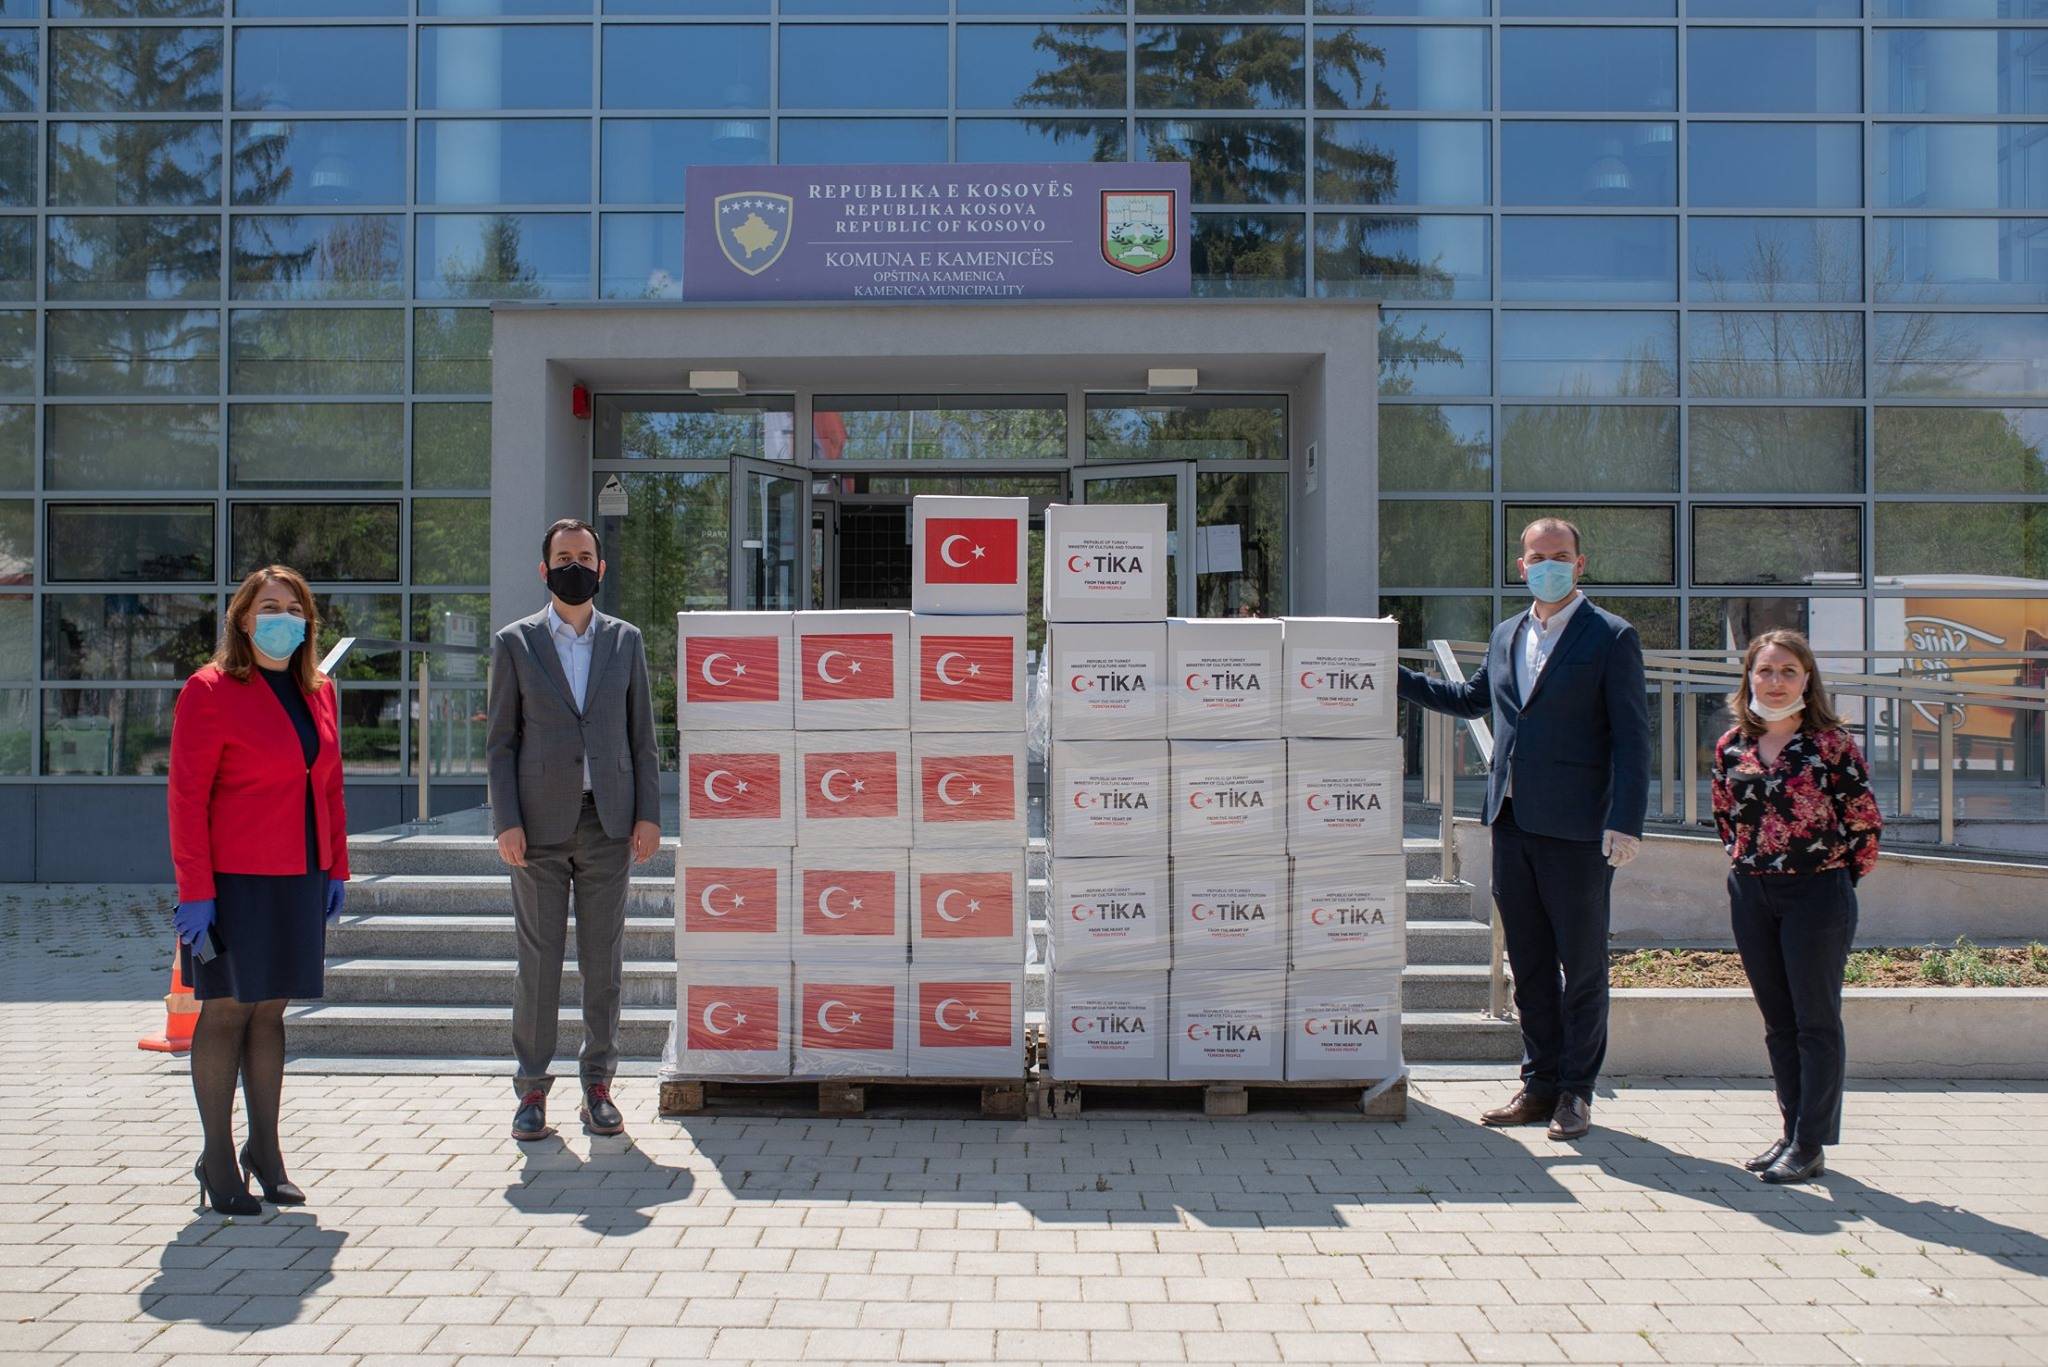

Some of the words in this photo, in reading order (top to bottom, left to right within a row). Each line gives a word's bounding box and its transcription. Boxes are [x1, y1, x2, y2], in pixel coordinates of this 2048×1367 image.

[809, 183, 940, 199] REPUBLIKA
[948, 183, 959, 198] E
[968, 179, 1073, 198] KOSOVËS
[846, 203, 954, 216] REPUBLIKA
[961, 202, 1035, 216] KOSOVA
[836, 220, 931, 233] REPUBLIC
[937, 219, 961, 232] OF
[968, 219, 1045, 232] KOSOVO
[826, 251, 915, 267] KOMUNA
[921, 251, 931, 266] E
[938, 248, 1054, 267] KAMENICËS
[873, 269, 930, 282] OPŠTINA
[934, 270, 1004, 282] KAMENICA
[854, 285, 926, 297] KAMENICA
[929, 284, 1025, 297] MUNICIPALITY
[1093, 552, 1142, 572] TİKA
[1096, 670, 1145, 691] TİKA
[1211, 669, 1260, 690] TİKA
[1325, 669, 1374, 689] TİKA
[1099, 788, 1148, 808] TİKA
[1214, 786, 1263, 808] TİKA
[1332, 789, 1380, 810] TİKA
[1096, 898, 1145, 920] TİKA
[1216, 900, 1265, 920] TİKA
[1336, 904, 1384, 924] TİKA
[1096, 1013, 1145, 1032] TİKA
[1212, 1021, 1261, 1040] TİKA
[1329, 1015, 1378, 1035] TİKA
